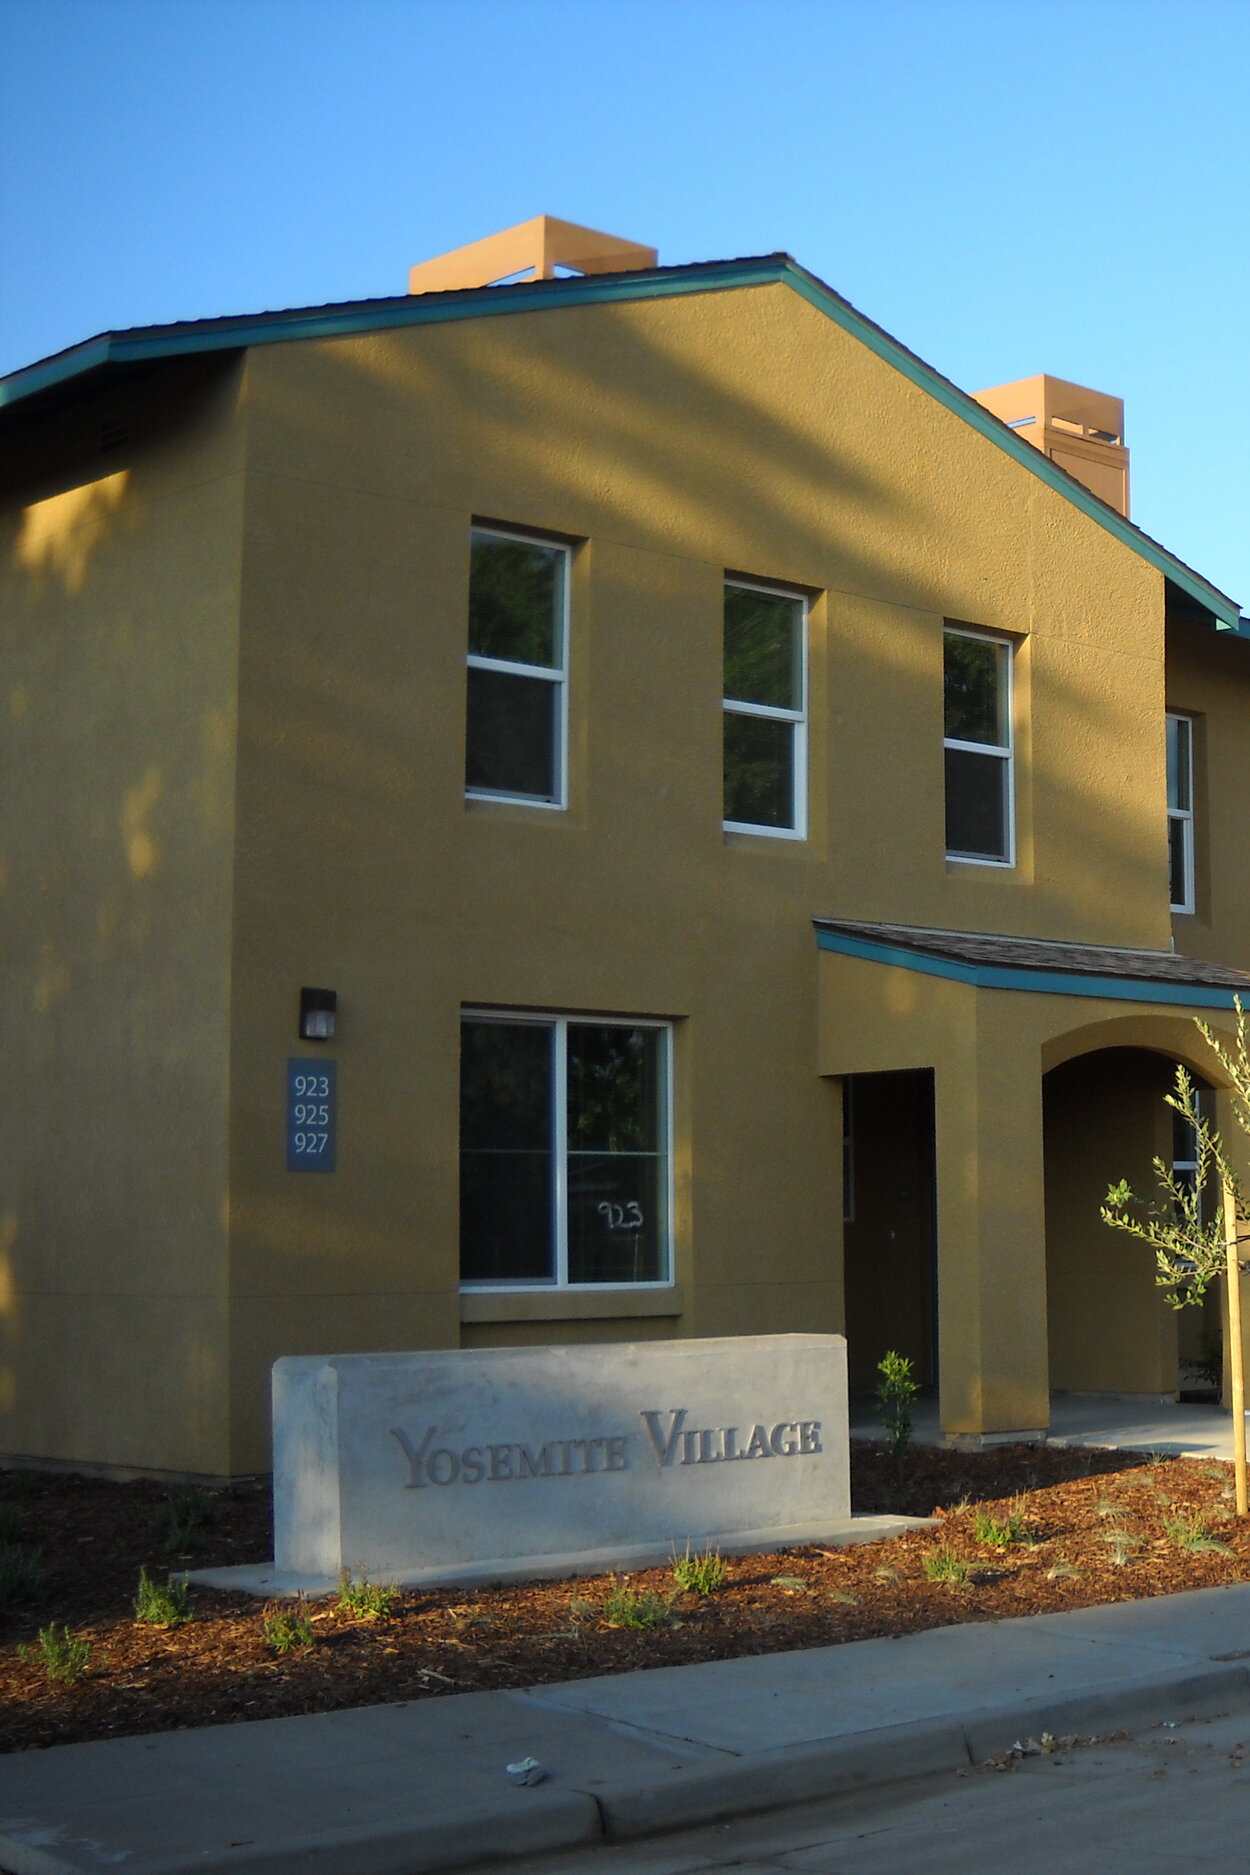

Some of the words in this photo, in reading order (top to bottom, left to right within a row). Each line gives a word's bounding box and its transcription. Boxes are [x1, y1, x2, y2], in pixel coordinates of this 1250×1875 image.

[295, 1076, 329, 1096] 923
[295, 1104, 329, 1124] 925
[294, 1132, 329, 1153] 927
[391, 1425, 630, 1489] YOSEMITE
[640, 1408, 823, 1467] VILLAGE
